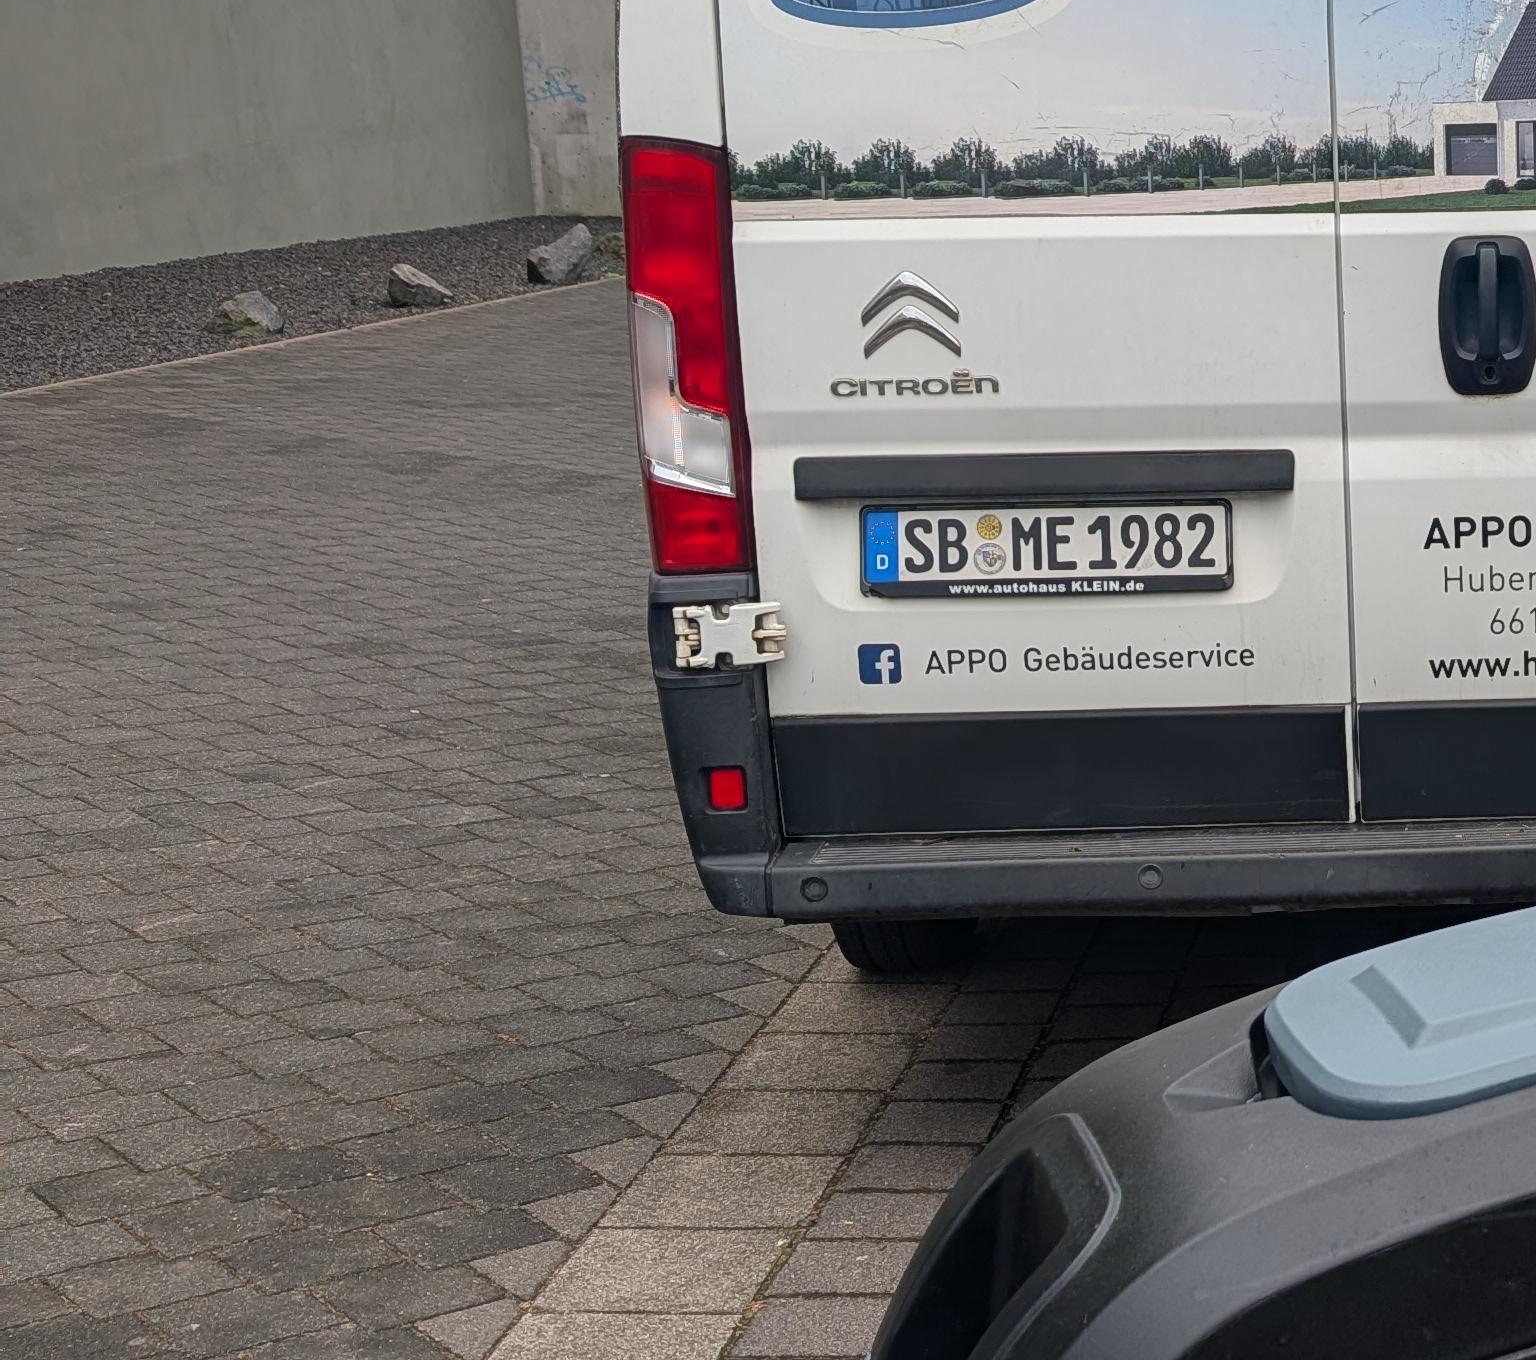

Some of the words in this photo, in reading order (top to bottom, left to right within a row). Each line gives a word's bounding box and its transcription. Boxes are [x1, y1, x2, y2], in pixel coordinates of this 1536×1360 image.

[830, 368, 1000, 398] CITROËN
[904, 518, 970, 574] SB
[1011, 515, 1078, 572] ME
[1087, 513, 1217, 571] 1982
[1423, 515, 1533, 551] APPO
[875, 554, 889, 571] D
[948, 580, 1066, 594] www.autohaus
[1071, 578, 1145, 593] KLEIN.de
[925, 648, 1008, 676] APPO
[1022, 643, 1256, 672] Gebäudeservice
